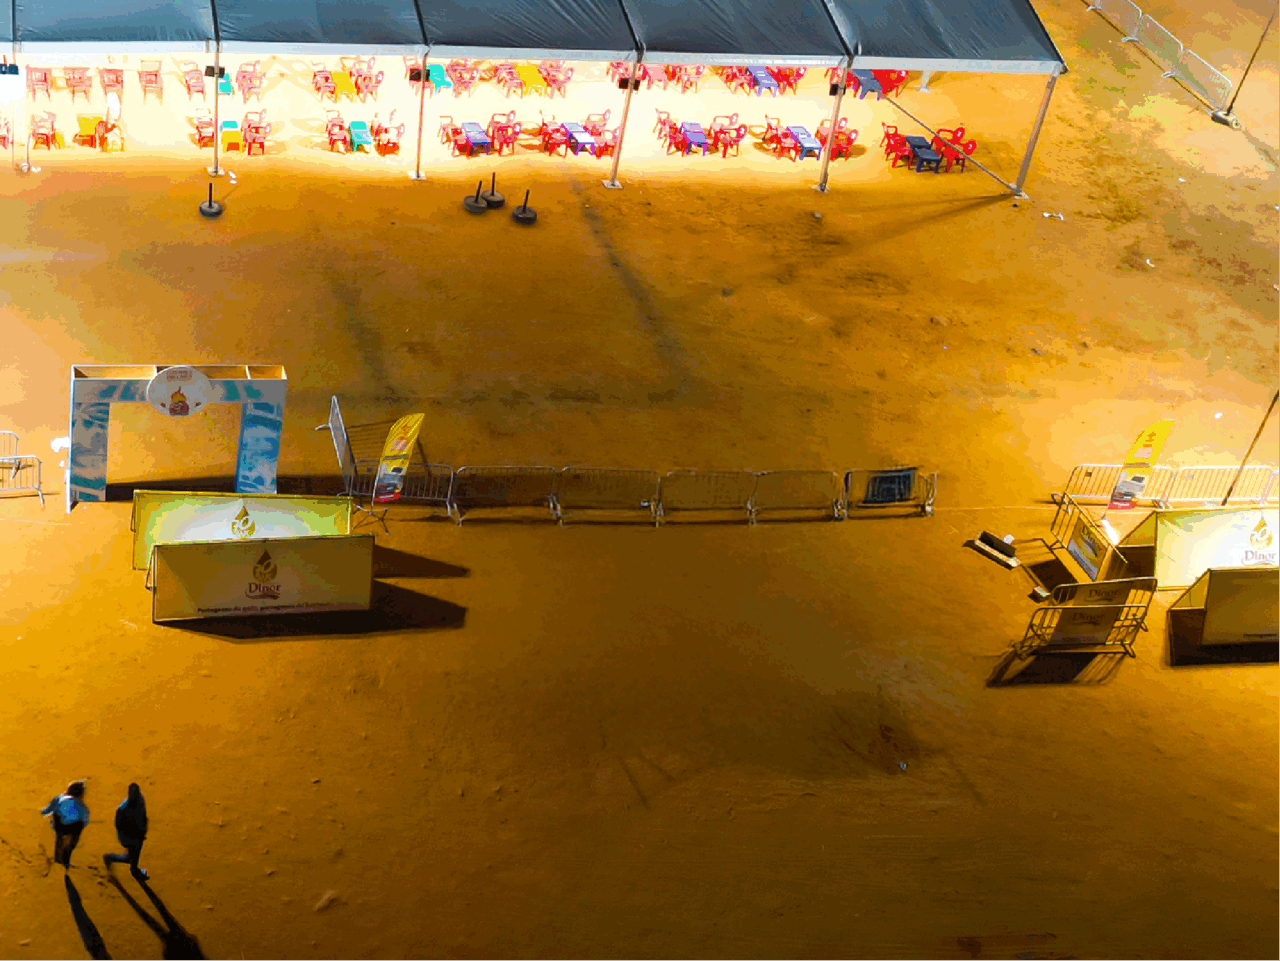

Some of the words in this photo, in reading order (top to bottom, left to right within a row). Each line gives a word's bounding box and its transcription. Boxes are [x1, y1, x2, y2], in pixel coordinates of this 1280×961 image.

[1244, 550, 1277, 561] Dinor
[248, 582, 282, 594] Dinor
[1089, 588, 1119, 599] Dinor
